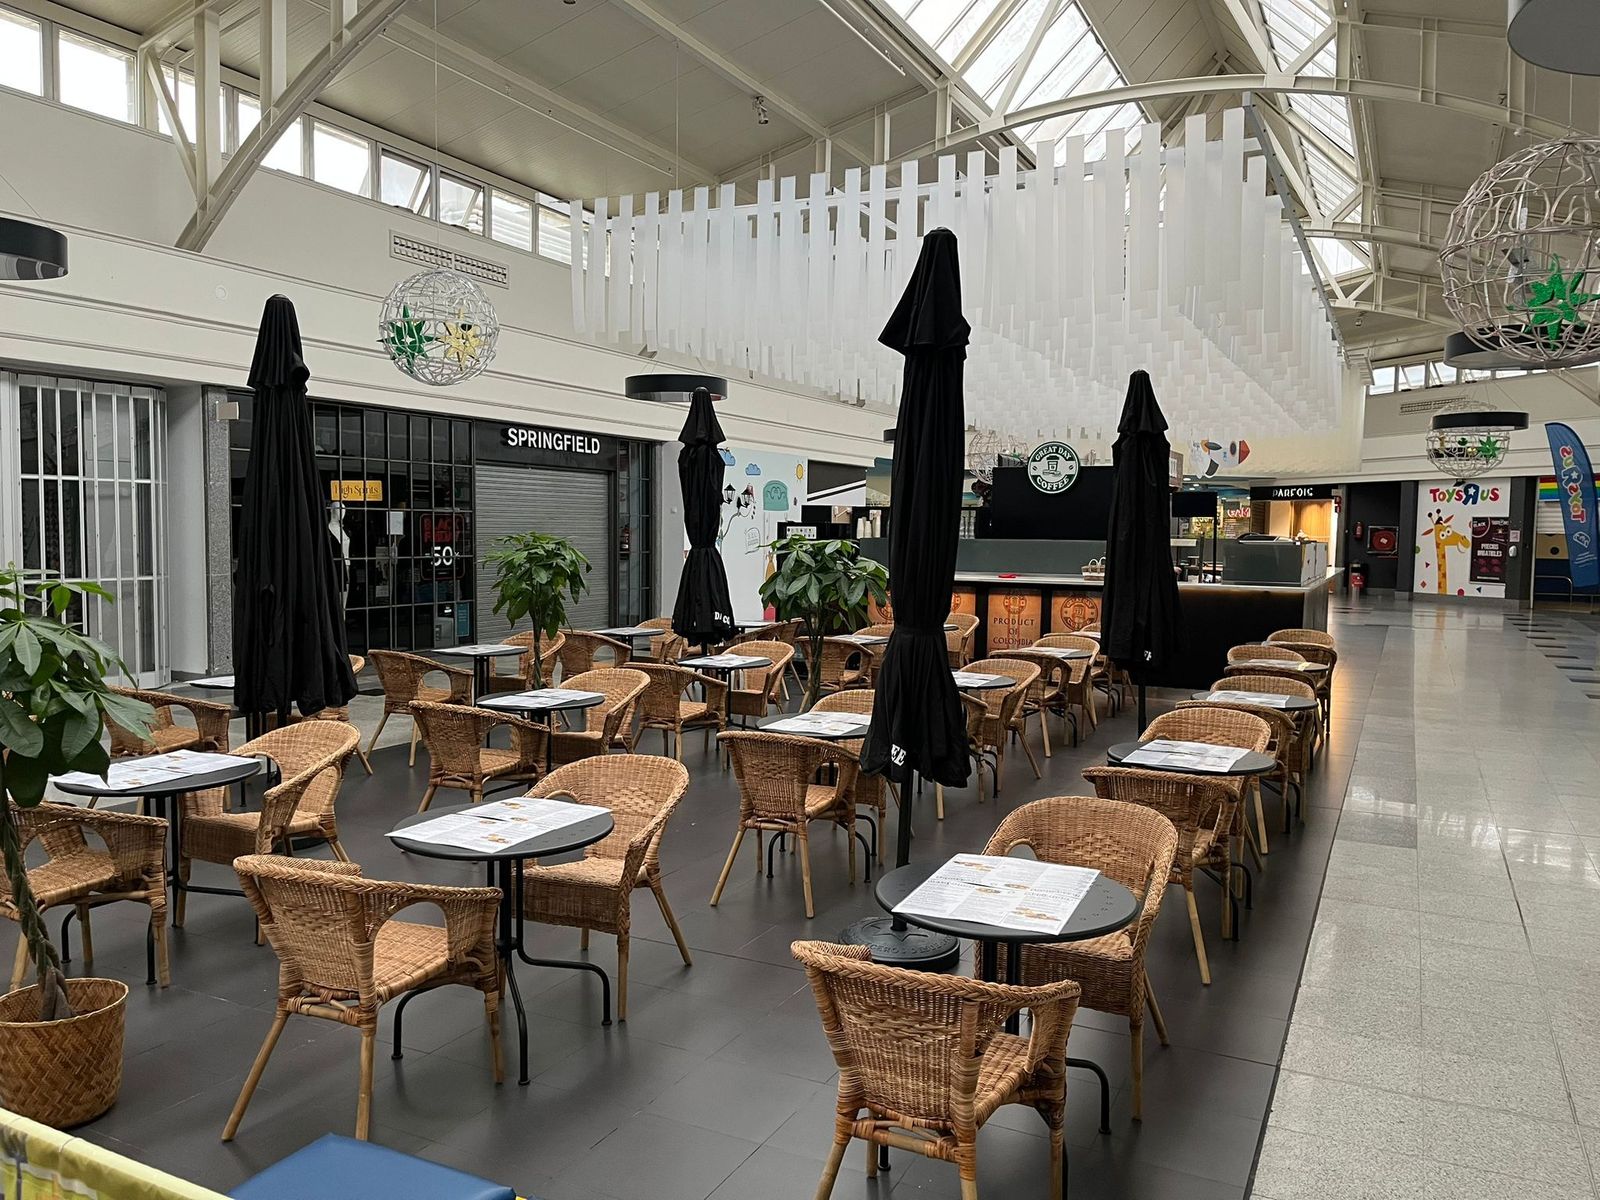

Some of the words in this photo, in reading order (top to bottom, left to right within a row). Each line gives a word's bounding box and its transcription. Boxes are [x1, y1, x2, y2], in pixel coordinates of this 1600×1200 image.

[507, 428, 600, 454] SPRINGFIELD
[1035, 446, 1057, 461] GREAT
[1058, 447, 1071, 460] DAY
[1036, 475, 1070, 490] COFFEE
[334, 484, 353, 499] Hgh
[354, 485, 379, 497] Sprits
[423, 518, 460, 530] BACK
[993, 617, 1035, 626] PRODUCT
[1009, 627, 1018, 635] OF
[993, 637, 1034, 646] COLOMBIA
